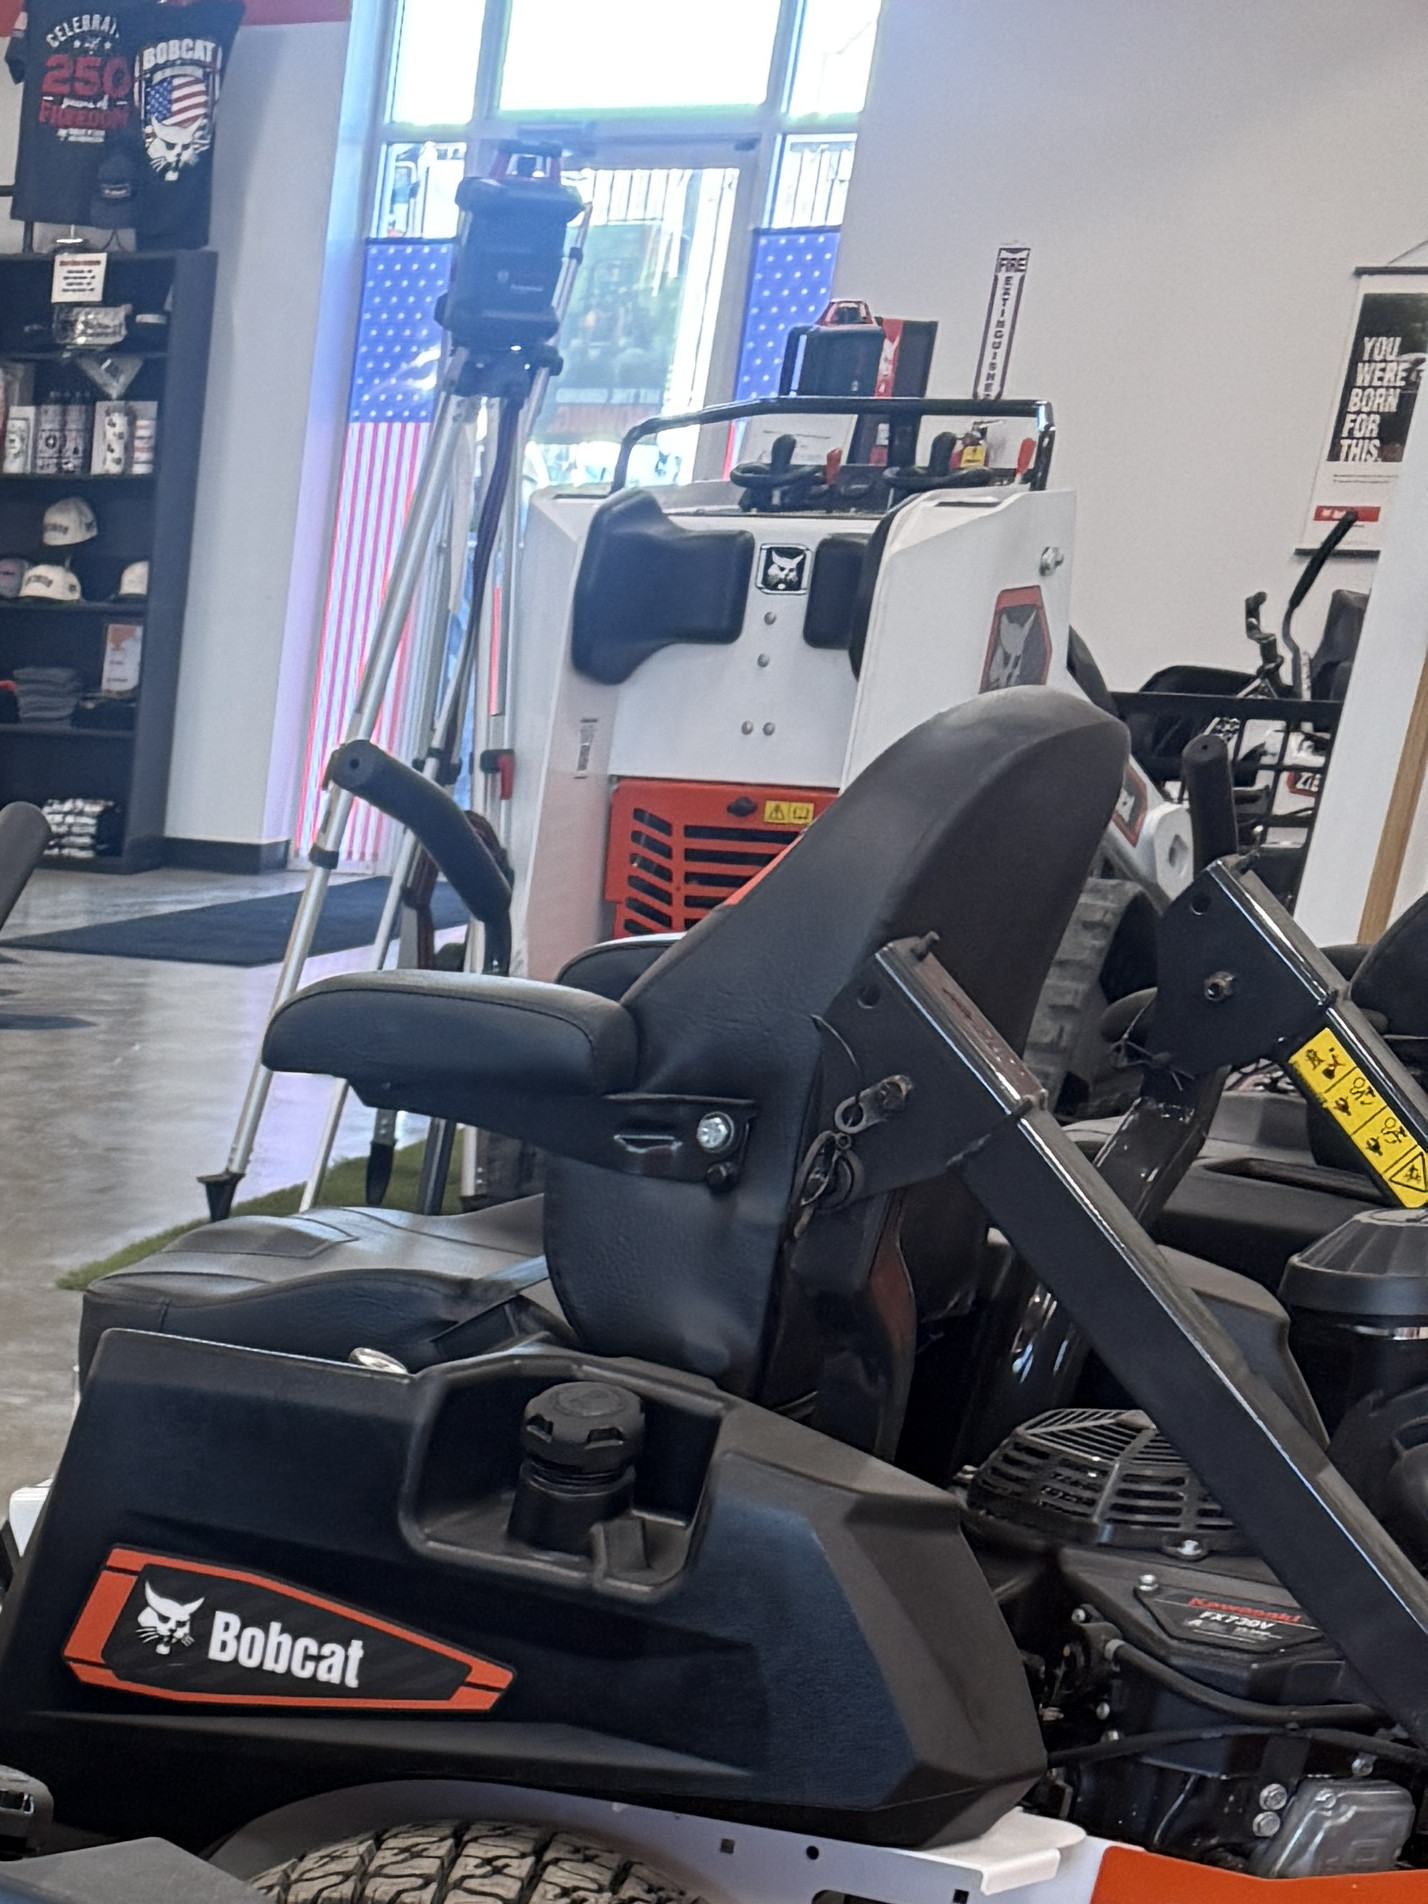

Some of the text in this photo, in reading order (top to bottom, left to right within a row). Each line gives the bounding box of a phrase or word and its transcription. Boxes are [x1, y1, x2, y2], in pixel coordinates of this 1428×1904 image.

[143, 38, 216, 70] BOBCAT
[40, 53, 132, 98] 250
[996, 257, 1027, 273] FIRE
[1362, 335, 1403, 361] YOU
[1355, 362, 1409, 387] WERE
[1346, 388, 1401, 413] BORN
[1341, 413, 1381, 438] FOR
[1339, 438, 1384, 463] THIS.
[208, 1610, 365, 1688] Bobcat
